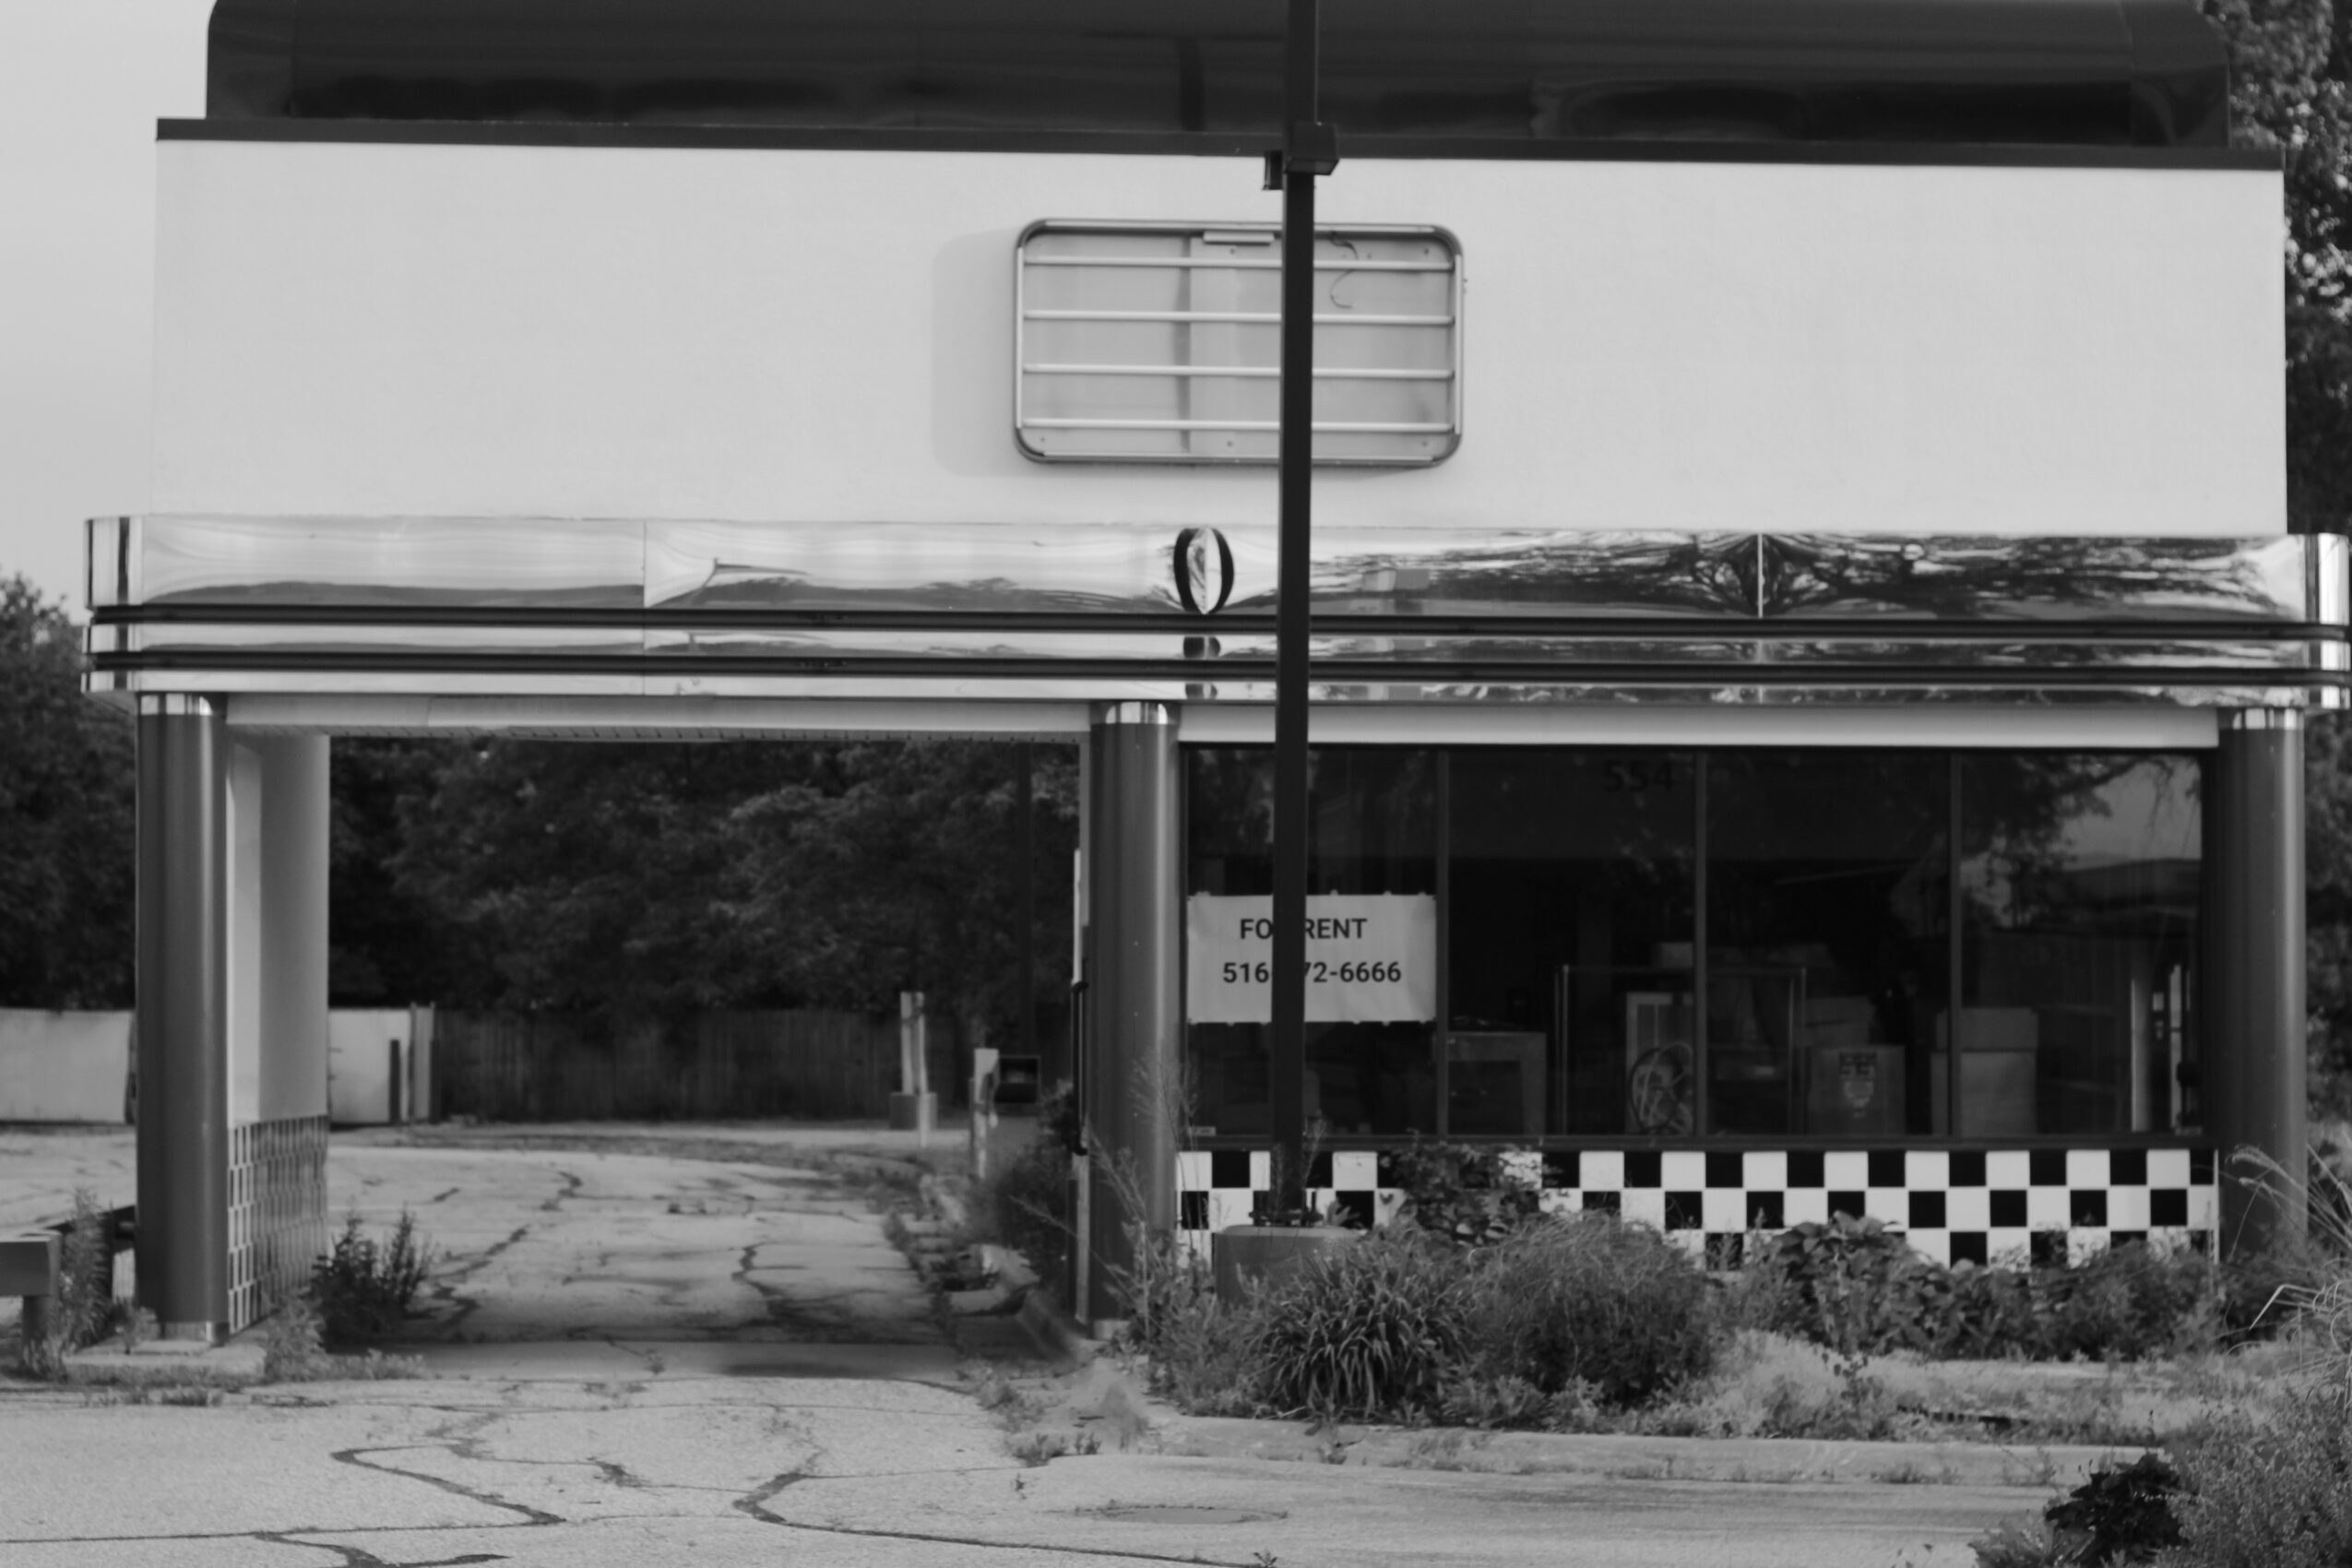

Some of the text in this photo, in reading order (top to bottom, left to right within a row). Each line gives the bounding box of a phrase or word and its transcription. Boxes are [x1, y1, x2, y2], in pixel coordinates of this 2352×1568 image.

[1604, 760, 1675, 792] 554
[1240, 918, 1368, 940] FO RENT
